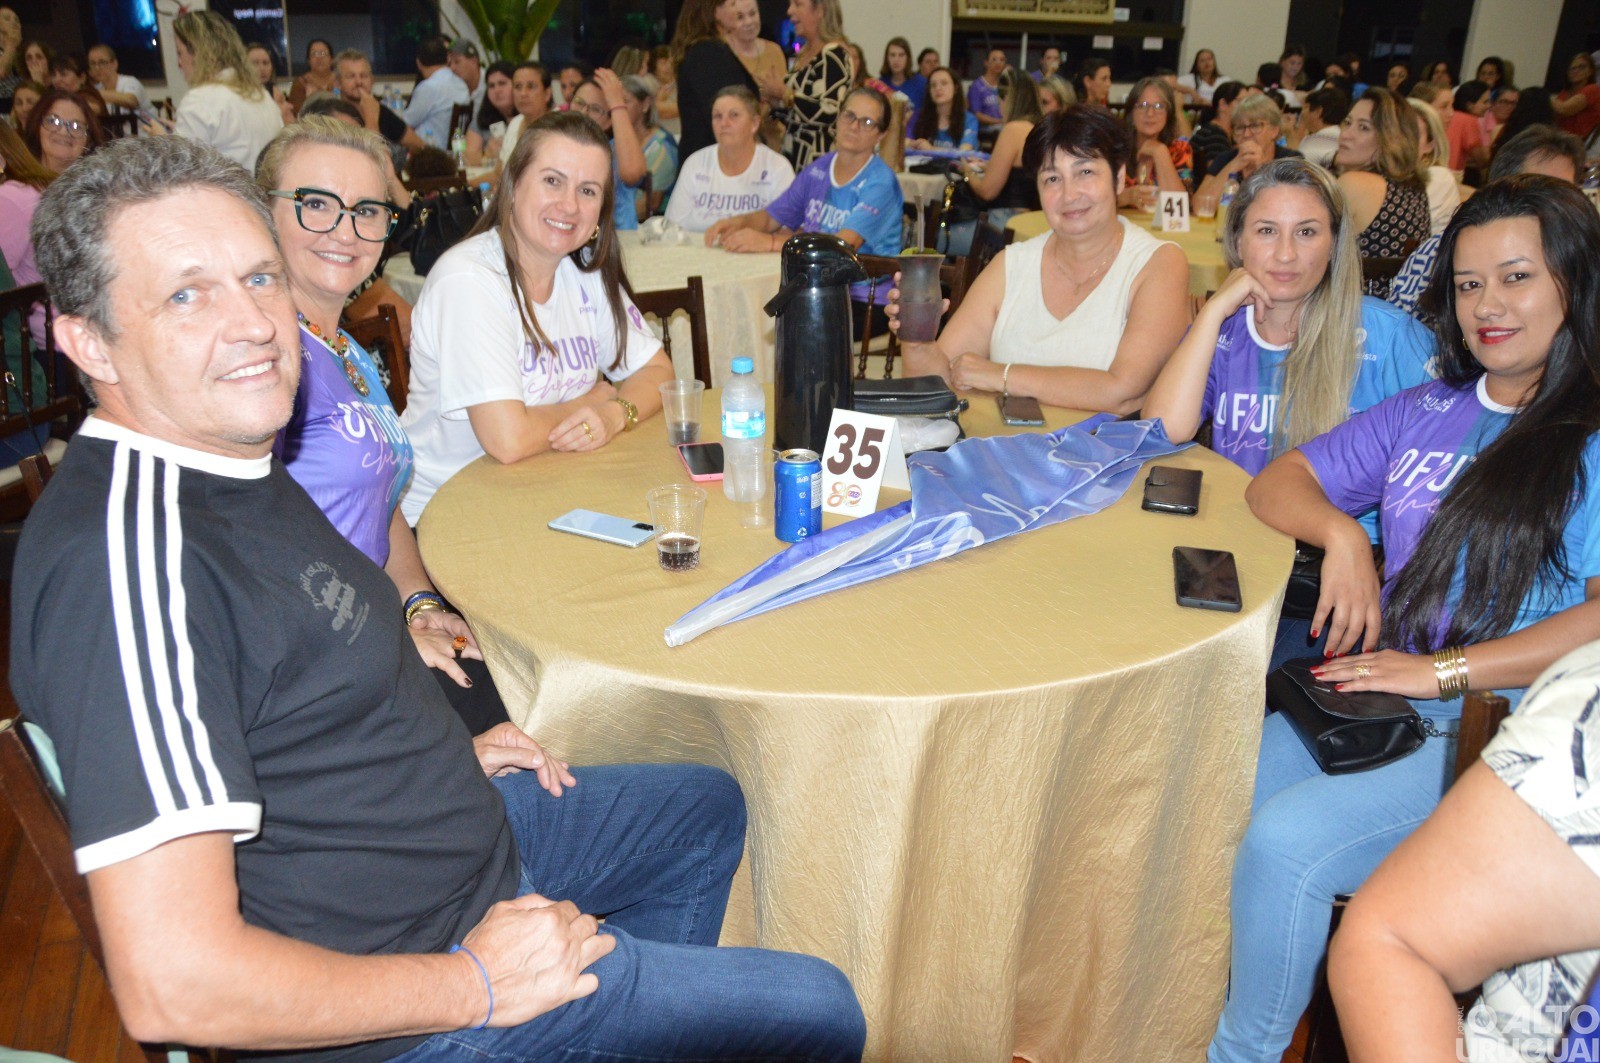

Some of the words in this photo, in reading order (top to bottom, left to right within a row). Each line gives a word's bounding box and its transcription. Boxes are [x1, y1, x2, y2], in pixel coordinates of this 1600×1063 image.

[707, 194, 759, 210] FUTURO
[1164, 197, 1183, 217] 41
[827, 423, 885, 480] 35
[1388, 448, 1419, 484] O
